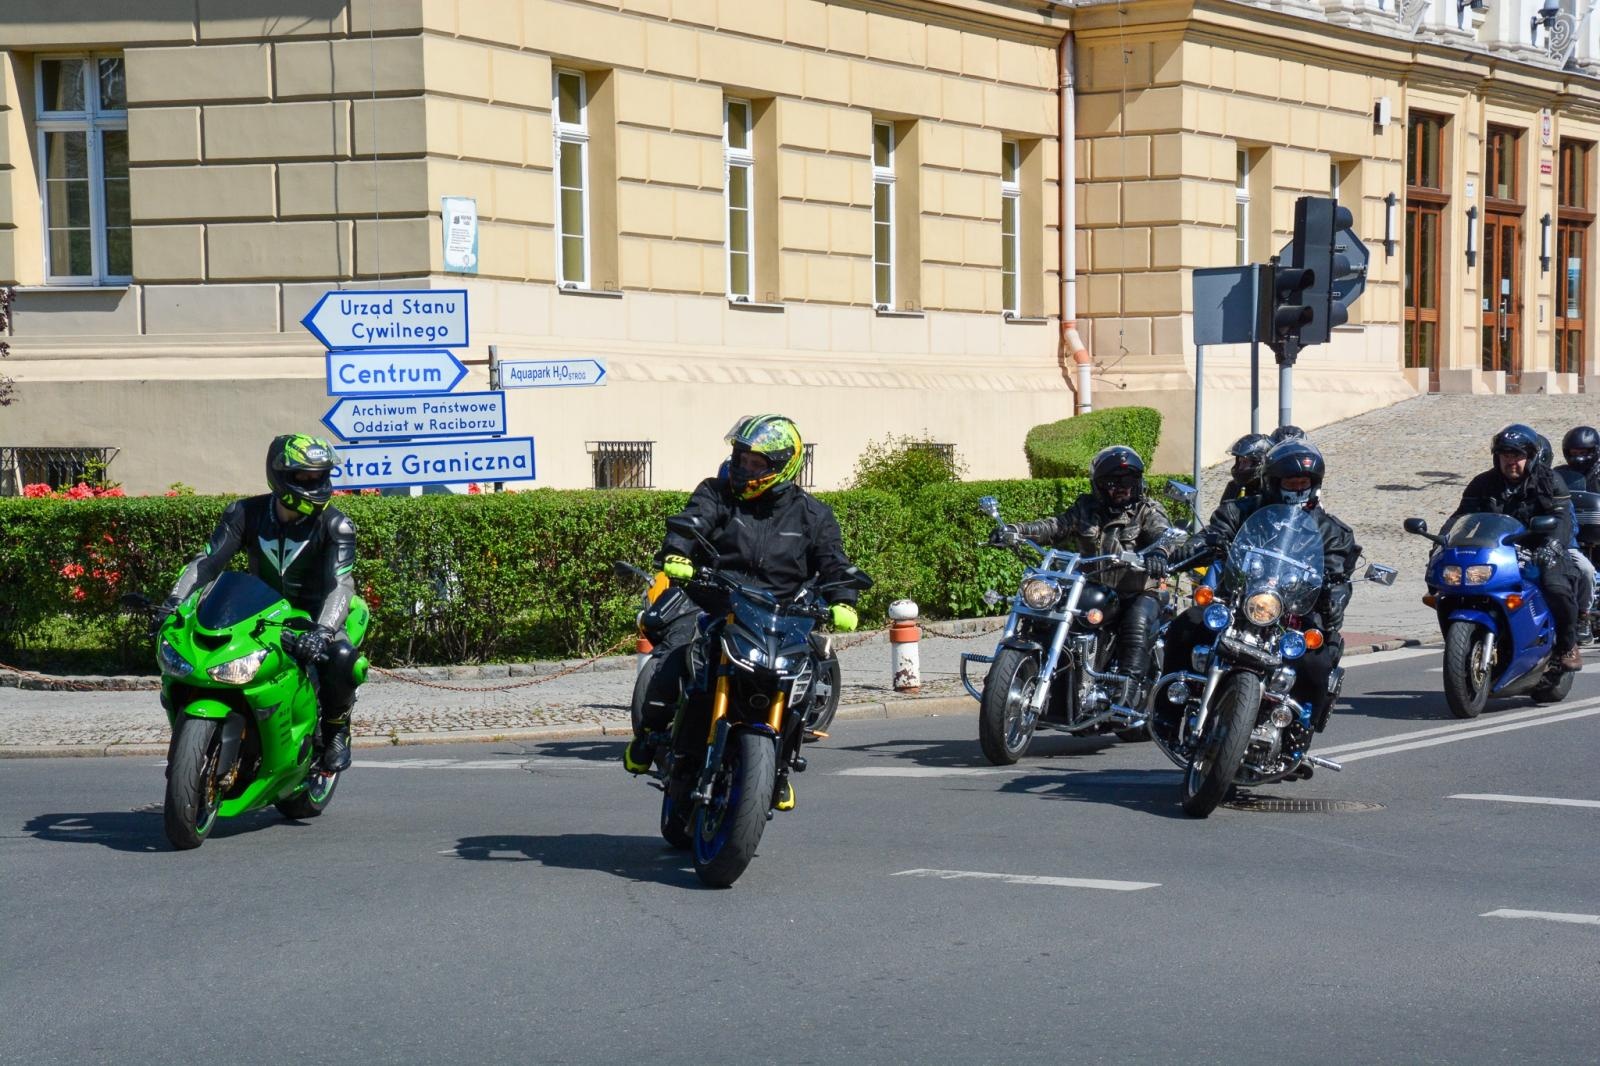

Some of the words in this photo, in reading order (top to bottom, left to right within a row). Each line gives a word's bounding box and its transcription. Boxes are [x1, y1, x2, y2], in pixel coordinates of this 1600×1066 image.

[341, 298, 393, 319] Urząd
[402, 298, 455, 315] Stanu
[351, 322, 449, 343] Cywilnego
[338, 363, 442, 385] Centrum
[510, 366, 551, 382] Aquapark
[352, 404, 417, 417] Archiwum
[422, 400, 497, 415] Państwowe
[353, 419, 409, 433] Oddział
[413, 422, 424, 431] w
[429, 417, 496, 431] Raciborzu
[401, 452, 527, 476] Graniczna
